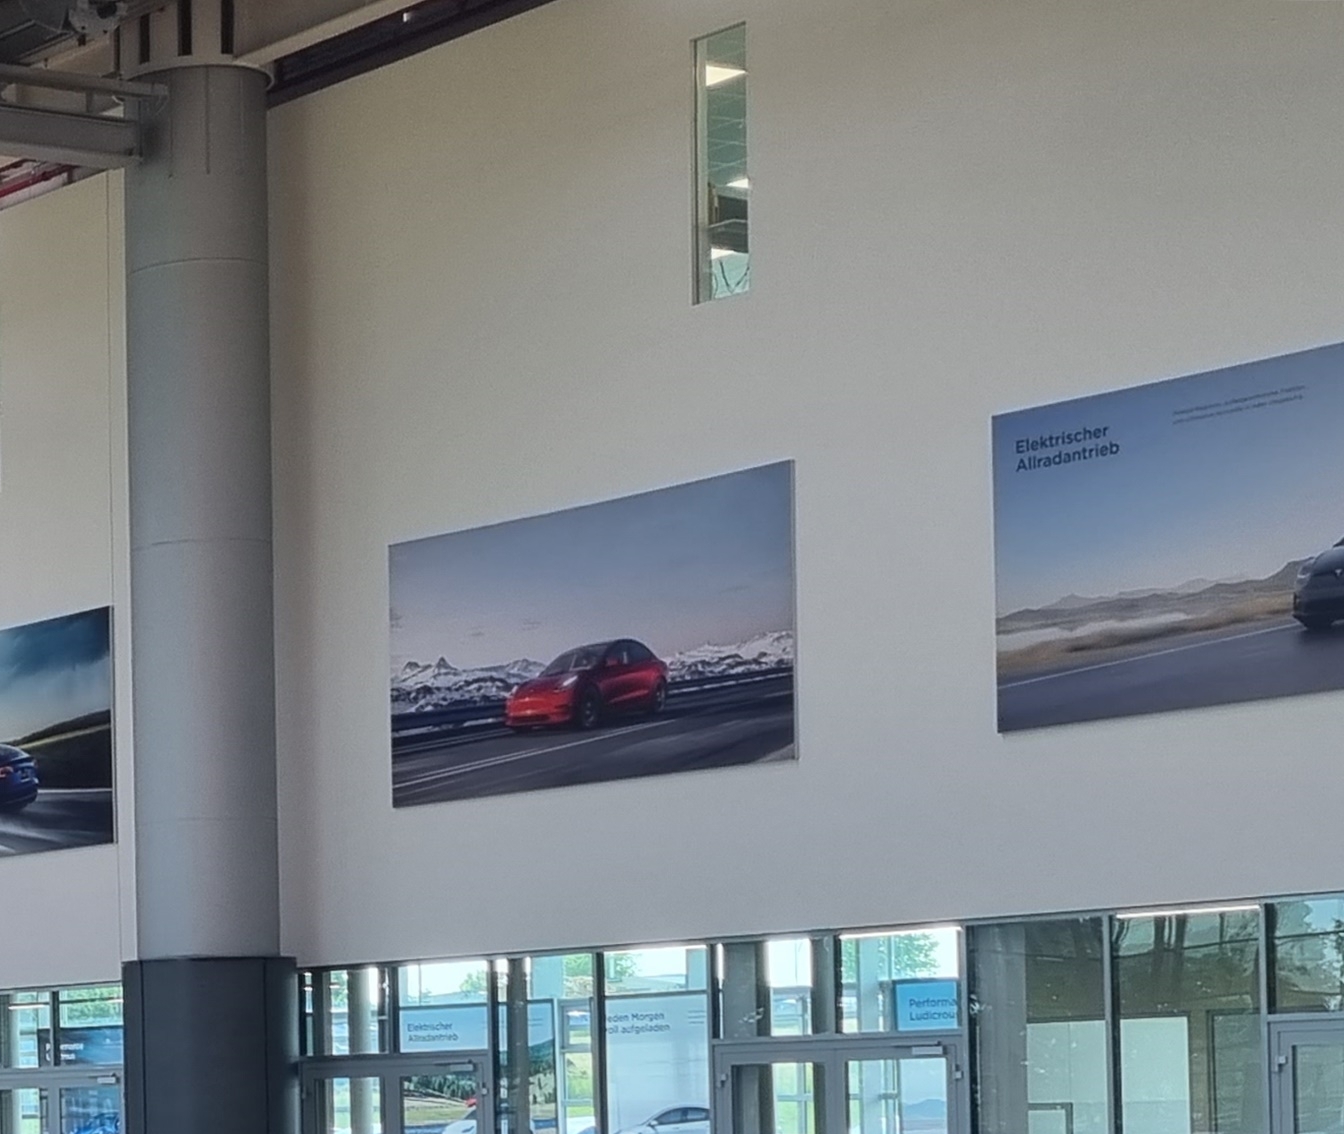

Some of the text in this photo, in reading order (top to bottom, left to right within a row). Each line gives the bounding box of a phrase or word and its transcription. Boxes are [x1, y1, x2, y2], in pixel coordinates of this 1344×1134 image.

[1015, 426, 1109, 454] Elektrischer
[1016, 441, 1120, 472] Allradantrieb
[608, 1012, 665, 1023] eden Morgen
